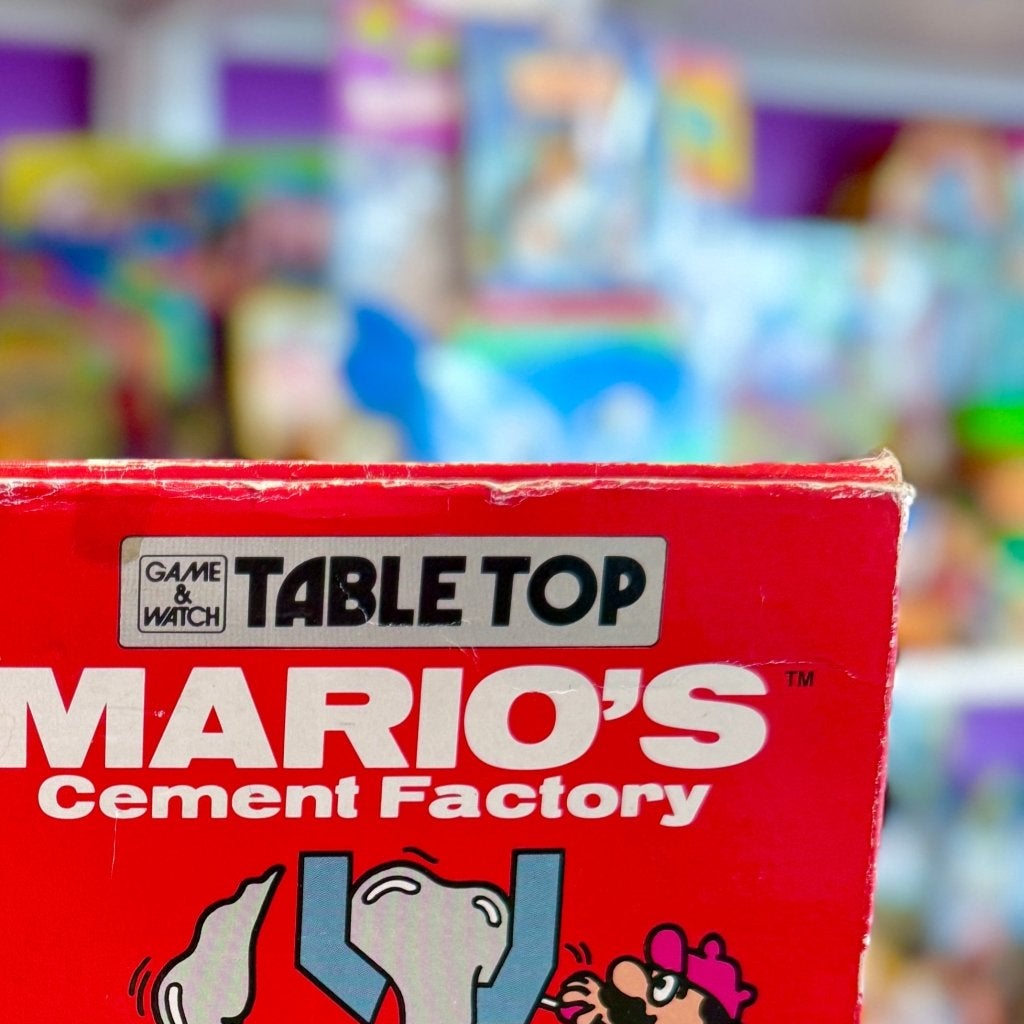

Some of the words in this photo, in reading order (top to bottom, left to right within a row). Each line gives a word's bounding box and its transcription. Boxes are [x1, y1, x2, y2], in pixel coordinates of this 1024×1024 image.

[145, 561, 221, 582] GAME
[174, 584, 192, 604] &
[234, 556, 466, 627] TABLE
[481, 555, 646, 626] TOP
[144, 607, 219, 626] WATCH
[38, 774, 359, 820] Cement
[380, 775, 711, 827] Factory
